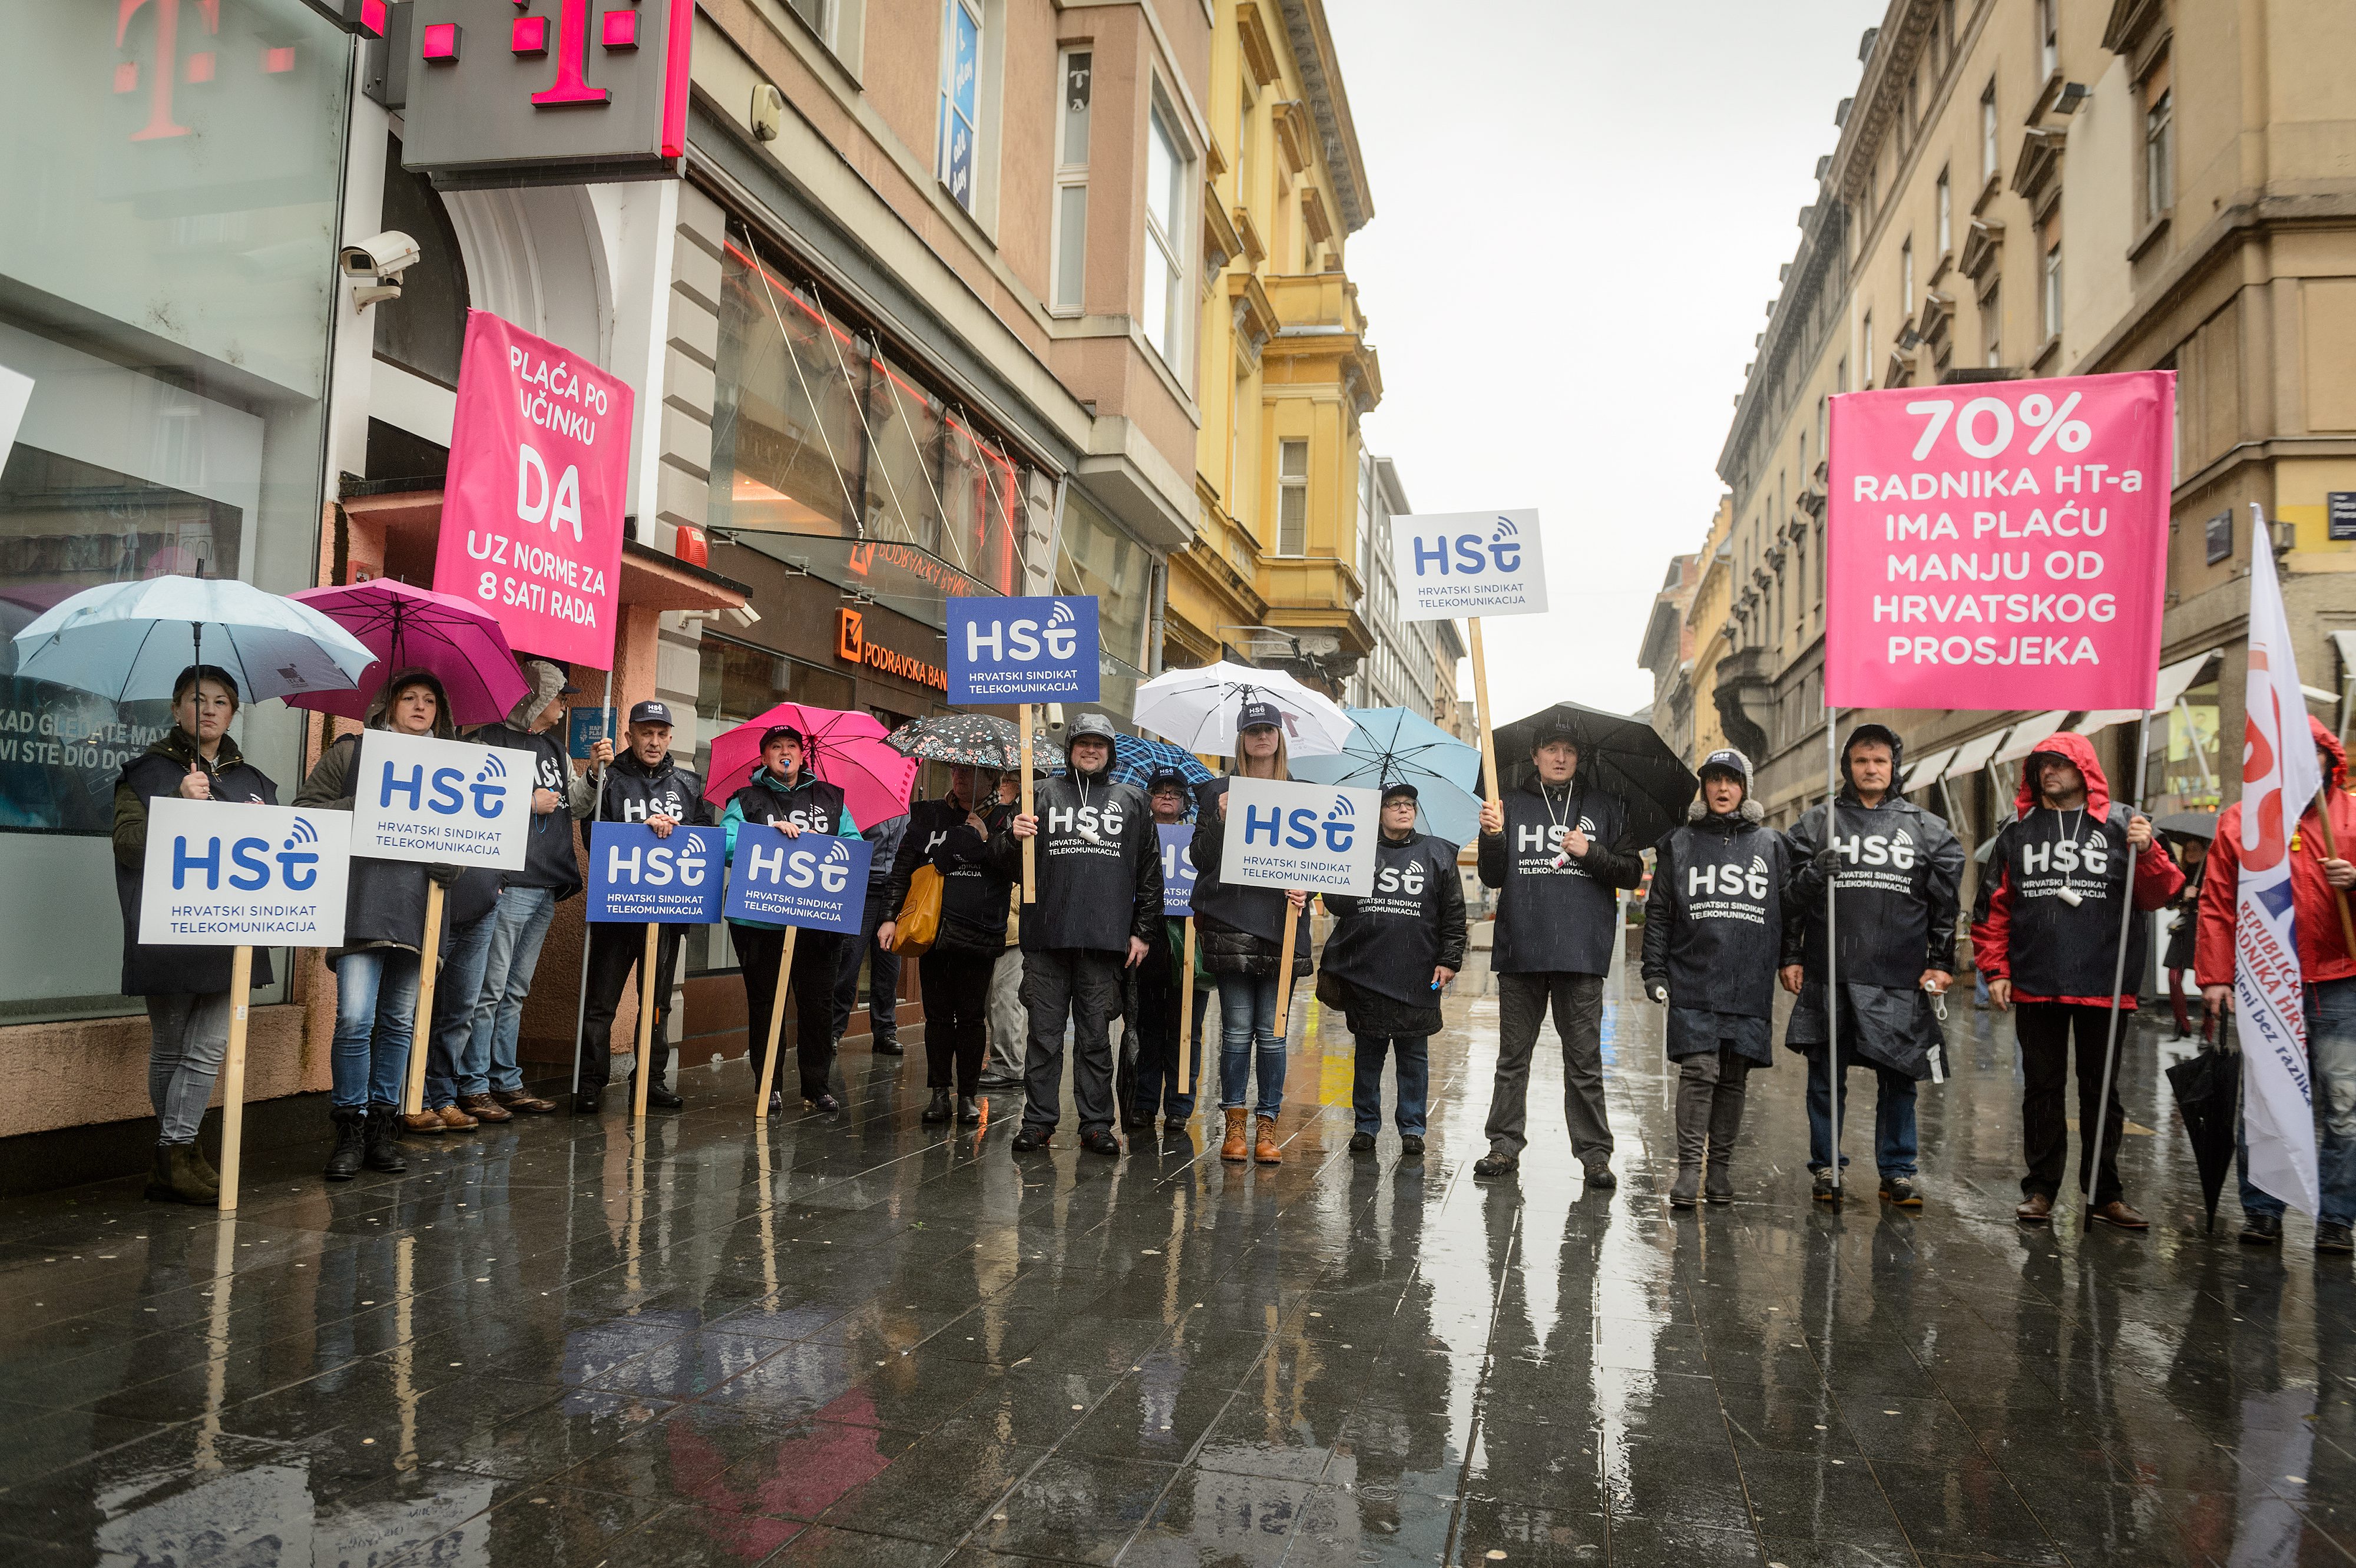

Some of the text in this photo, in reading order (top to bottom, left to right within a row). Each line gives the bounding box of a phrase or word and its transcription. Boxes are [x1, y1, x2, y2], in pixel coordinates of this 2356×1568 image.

[510, 345, 608, 416] PLAĆA PO
[519, 389, 595, 445] UČINKU
[1905, 391, 2092, 461] 70%
[517, 443, 583, 542] DA
[1854, 464, 2142, 502] RADNIKA HT-a
[1886, 500, 2107, 541] IMA PLAĆU
[467, 530, 605, 597] UZ NORME ZA
[1414, 534, 1521, 576] HSt
[1887, 550, 2104, 582] MANJU OD
[478, 571, 596, 629] 8 SATI RADA
[1418, 583, 1524, 596] HRVATSKI SINDIKAT
[1419, 596, 1526, 608] TELEKOMUNIKACIJA
[1873, 593, 2116, 623] HRVATSKOG
[967, 619, 1077, 662] HSt
[1888, 636, 2100, 665] PROSJEKA
[865, 641, 948, 692] PODRAVSKA BAN
[969, 670, 1077, 682] HRVATSKI SINDIKAT
[969, 682, 1078, 694] TELEKOMUNIKACIJA
[39, 714, 127, 744] GLEDATE
[0, 739, 16, 762] VI
[22, 741, 59, 766] STE
[64, 746, 98, 769] DIO
[380, 760, 507, 819] HSt
[378, 821, 502, 842] HRVATSKI SINDIKAT
[1049, 806, 1123, 835] HSt
[1245, 804, 1355, 853] HSt
[376, 836, 500, 856] TELEKOMUNIKACIJA
[1049, 839, 1085, 848] HRVATSKI
[1049, 847, 1121, 858] TELEKOMUNIKACIJA
[1833, 834, 1915, 869] HSt
[2023, 840, 2108, 875] HSt
[173, 835, 319, 891] HSt
[608, 845, 706, 886] HSt
[748, 844, 849, 893] HSt
[1242, 868, 1351, 885] TELEKOMUNIKACIJA
[1243, 856, 1352, 873] HRVATSKI SINDIKAT
[1163, 887, 1192, 896] ATSKI
[1377, 868, 1425, 895] St
[1689, 864, 1769, 900] HSt
[1834, 879, 1911, 895] TELEKOMUNIKACIJA
[1837, 871, 1912, 885] RVATSKI SINDIKAT
[2022, 878, 2063, 888] HRVATSKI
[171, 905, 317, 917] HRVATSKI SINDIKAT
[606, 905, 703, 915] TELEKOMUNIKACIJA
[607, 894, 704, 904] HRVATSKI SINDIKAT
[744, 901, 842, 922] TELEKOMUNIKACIJA
[746, 890, 843, 911] HRVATSKI SINDIKAT
[1356, 898, 1422, 909] HRVATSKI SINDIKAT
[1358, 906, 1421, 917] TELEKOMUNIKACIJA
[1689, 901, 1765, 915] HRVATSKI SINDIKAT
[170, 922, 316, 933] TELEKOMUNIKACIJA
[1690, 910, 1765, 924] TELEKOMUNIKACIJA
[2252, 1009, 2279, 1044] bez
